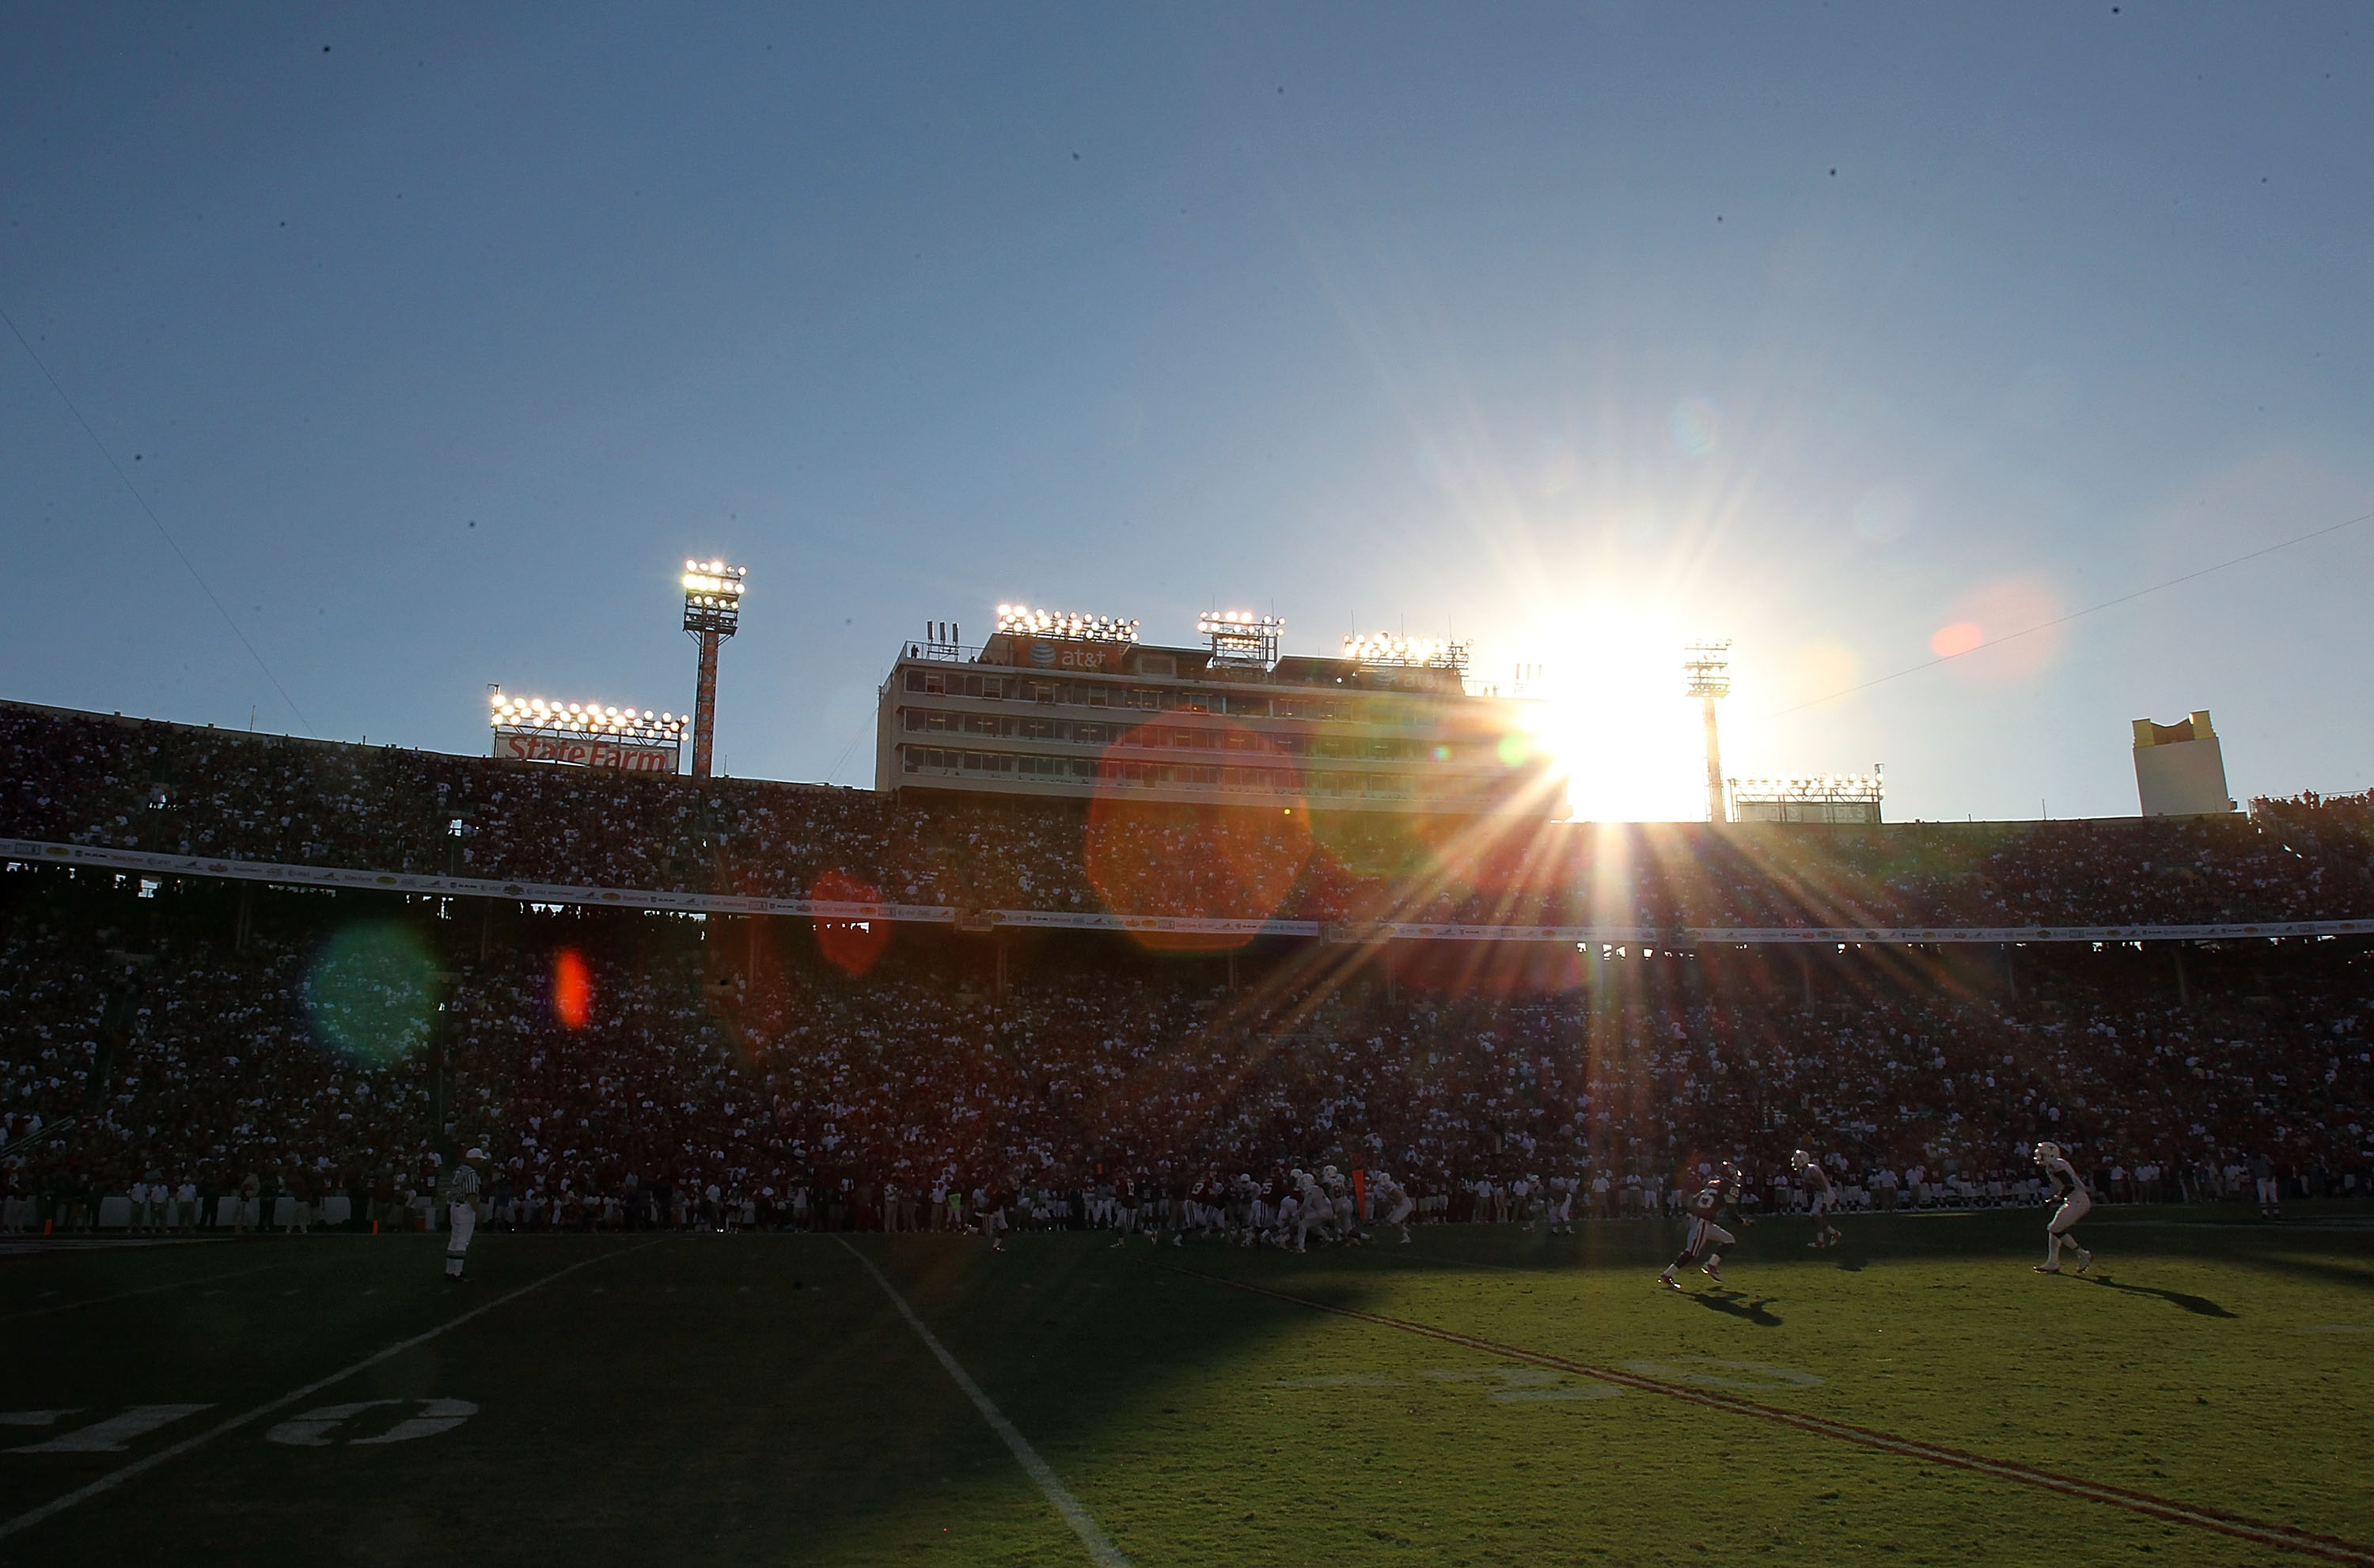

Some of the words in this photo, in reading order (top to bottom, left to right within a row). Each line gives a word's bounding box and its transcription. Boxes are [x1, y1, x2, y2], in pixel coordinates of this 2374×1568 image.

[1062, 649, 1106, 668] at&t
[506, 736, 586, 765] State
[589, 741, 666, 772] Farm
